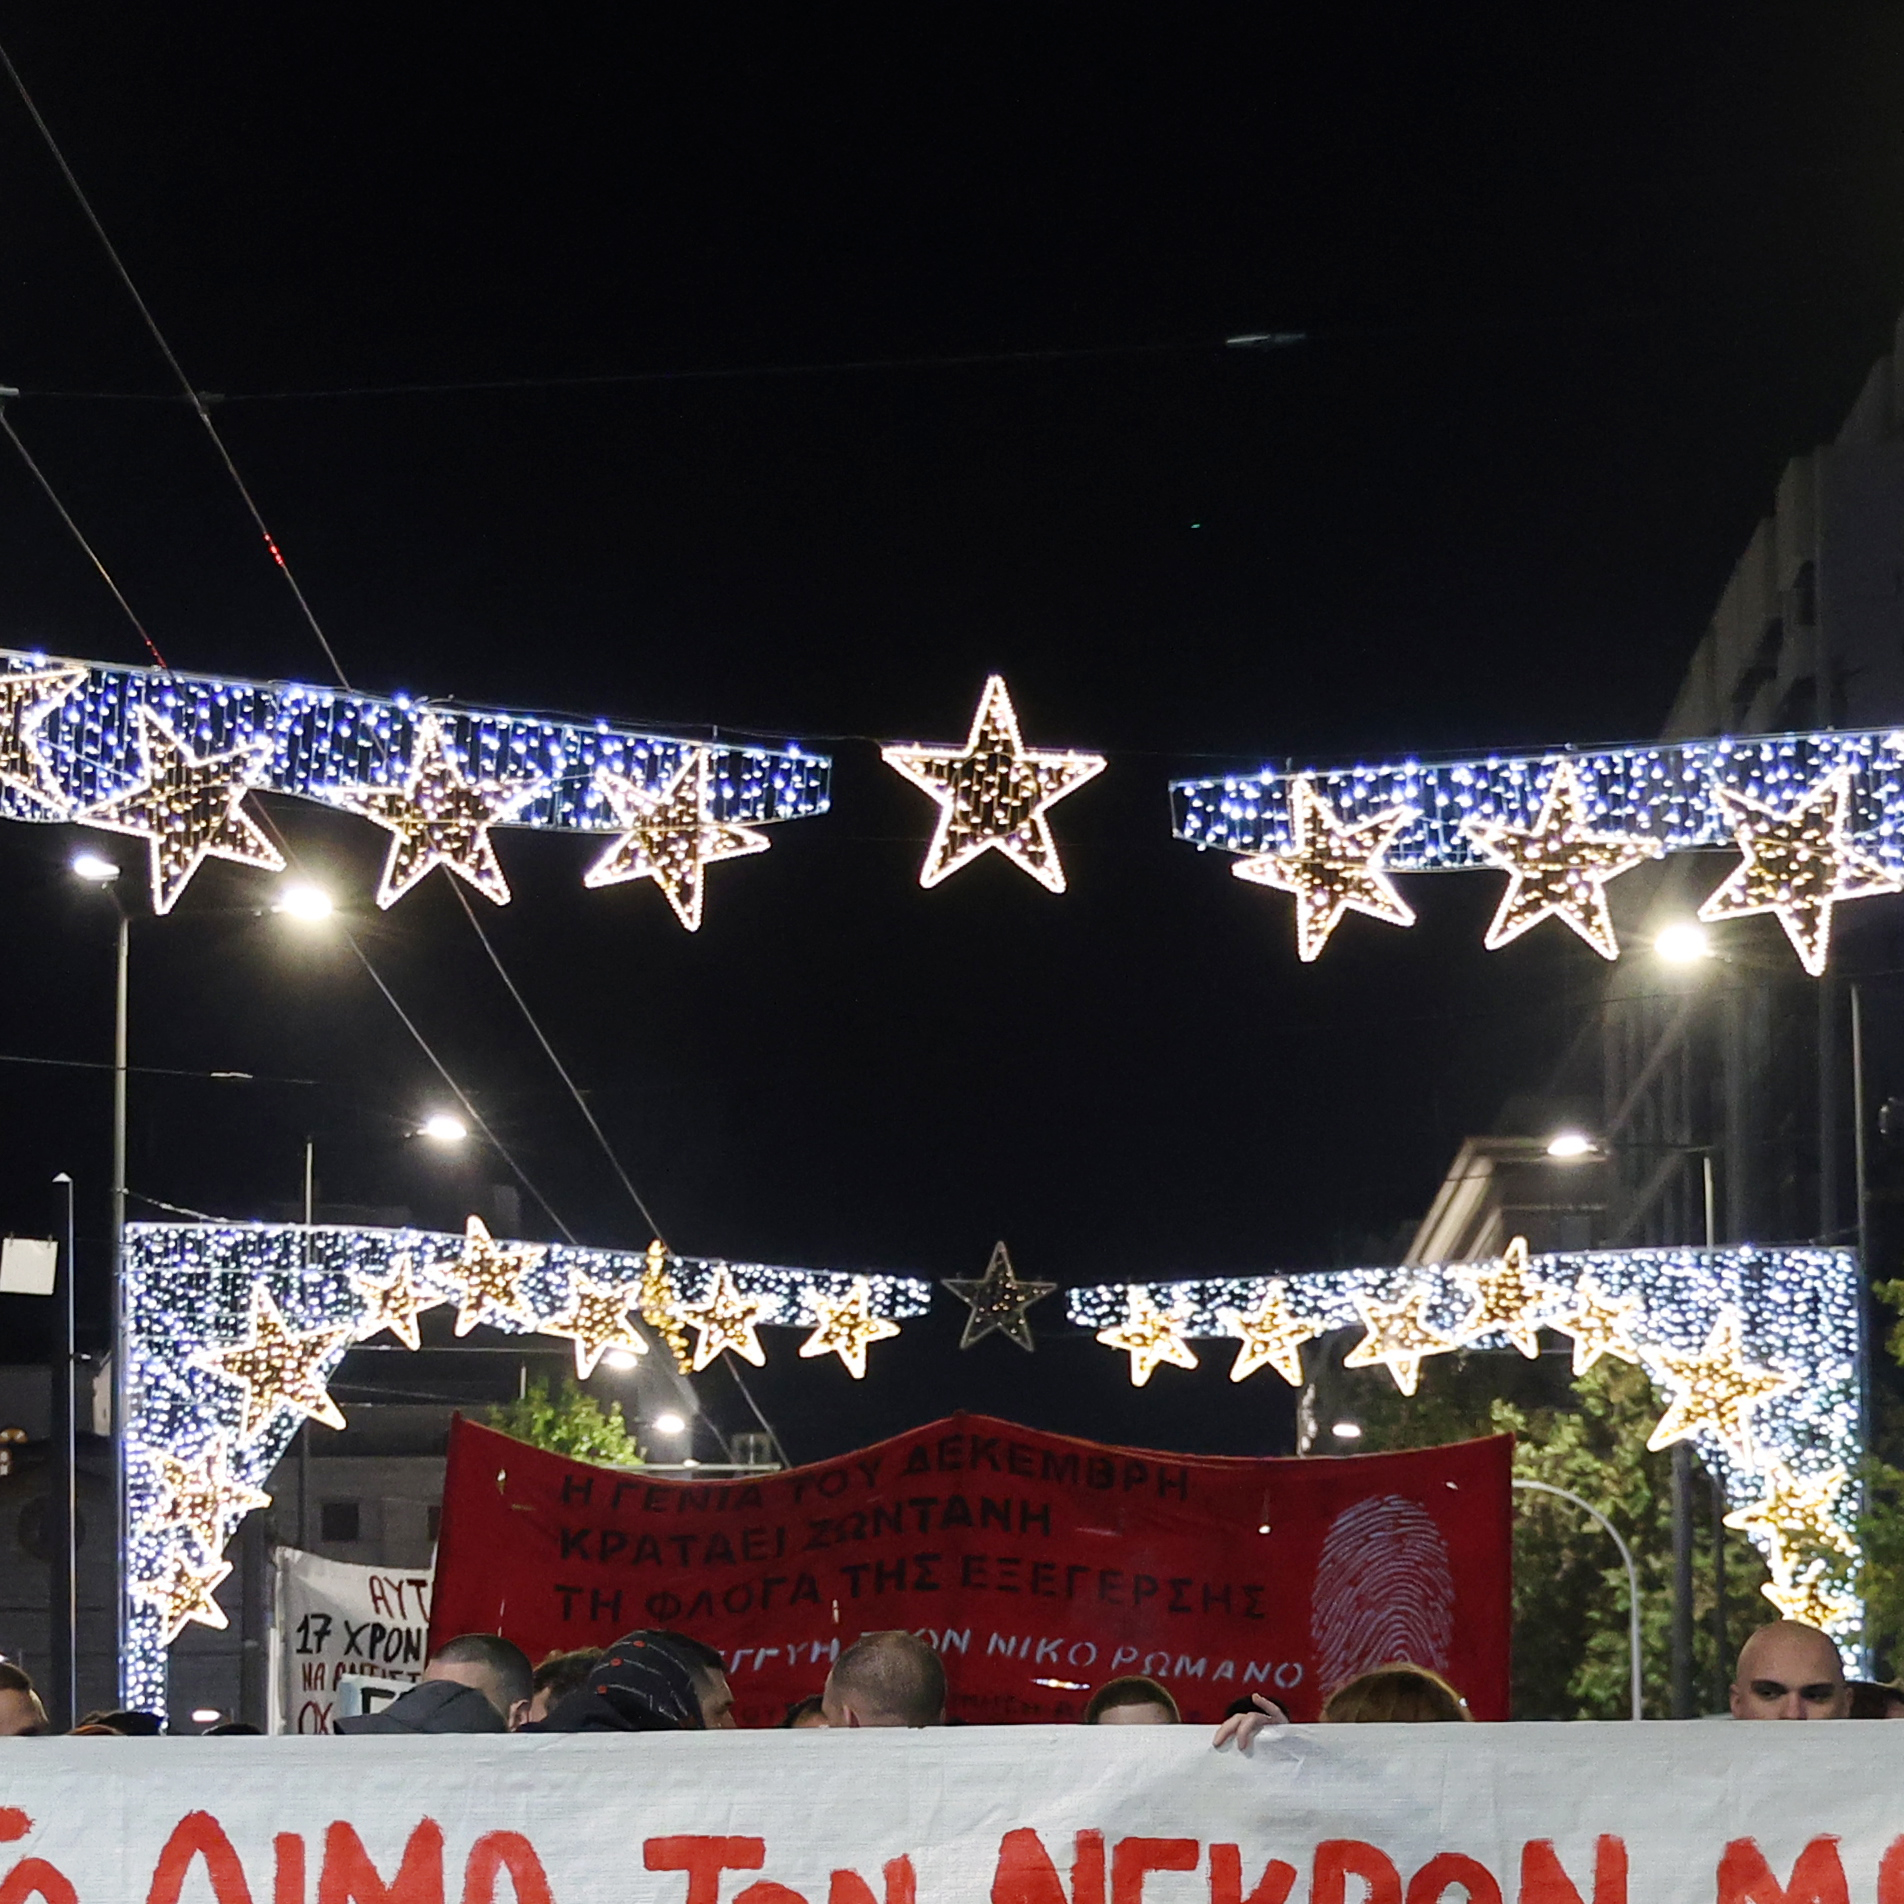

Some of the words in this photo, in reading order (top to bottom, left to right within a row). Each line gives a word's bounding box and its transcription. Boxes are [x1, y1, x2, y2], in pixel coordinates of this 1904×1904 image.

[560, 1474, 595, 1506] Η
[610, 1482, 764, 1513] ΓΕΝΙΑ
[788, 1457, 883, 1505] ΤΟΥ
[901, 1432, 1188, 1501] ΔΕΚΕΜΒΡΗ
[559, 1526, 787, 1568] ΚΡΑΤΑΕΙ
[801, 1493, 1051, 1551] ΖΩΝΤΑΝΗ
[369, 1574, 431, 1622] ΑΥΤ
[554, 1583, 623, 1622] ΤΗ
[645, 1572, 823, 1623] ΦΛΟΓΑ
[840, 1552, 942, 1599] ΤΗΣ
[960, 1553, 1266, 1620] ΕΞΕΓΕΡΣΗΣ
[296, 1613, 333, 1654] 17
[344, 1620, 422, 1664] ΧΡΟΝ
[718, 1637, 841, 1674] ΓΓΥΗ
[986, 1631, 1097, 1667] ΝΙΚΟ
[1110, 1646, 1303, 1689] ΡΩΜΑΝΟ
